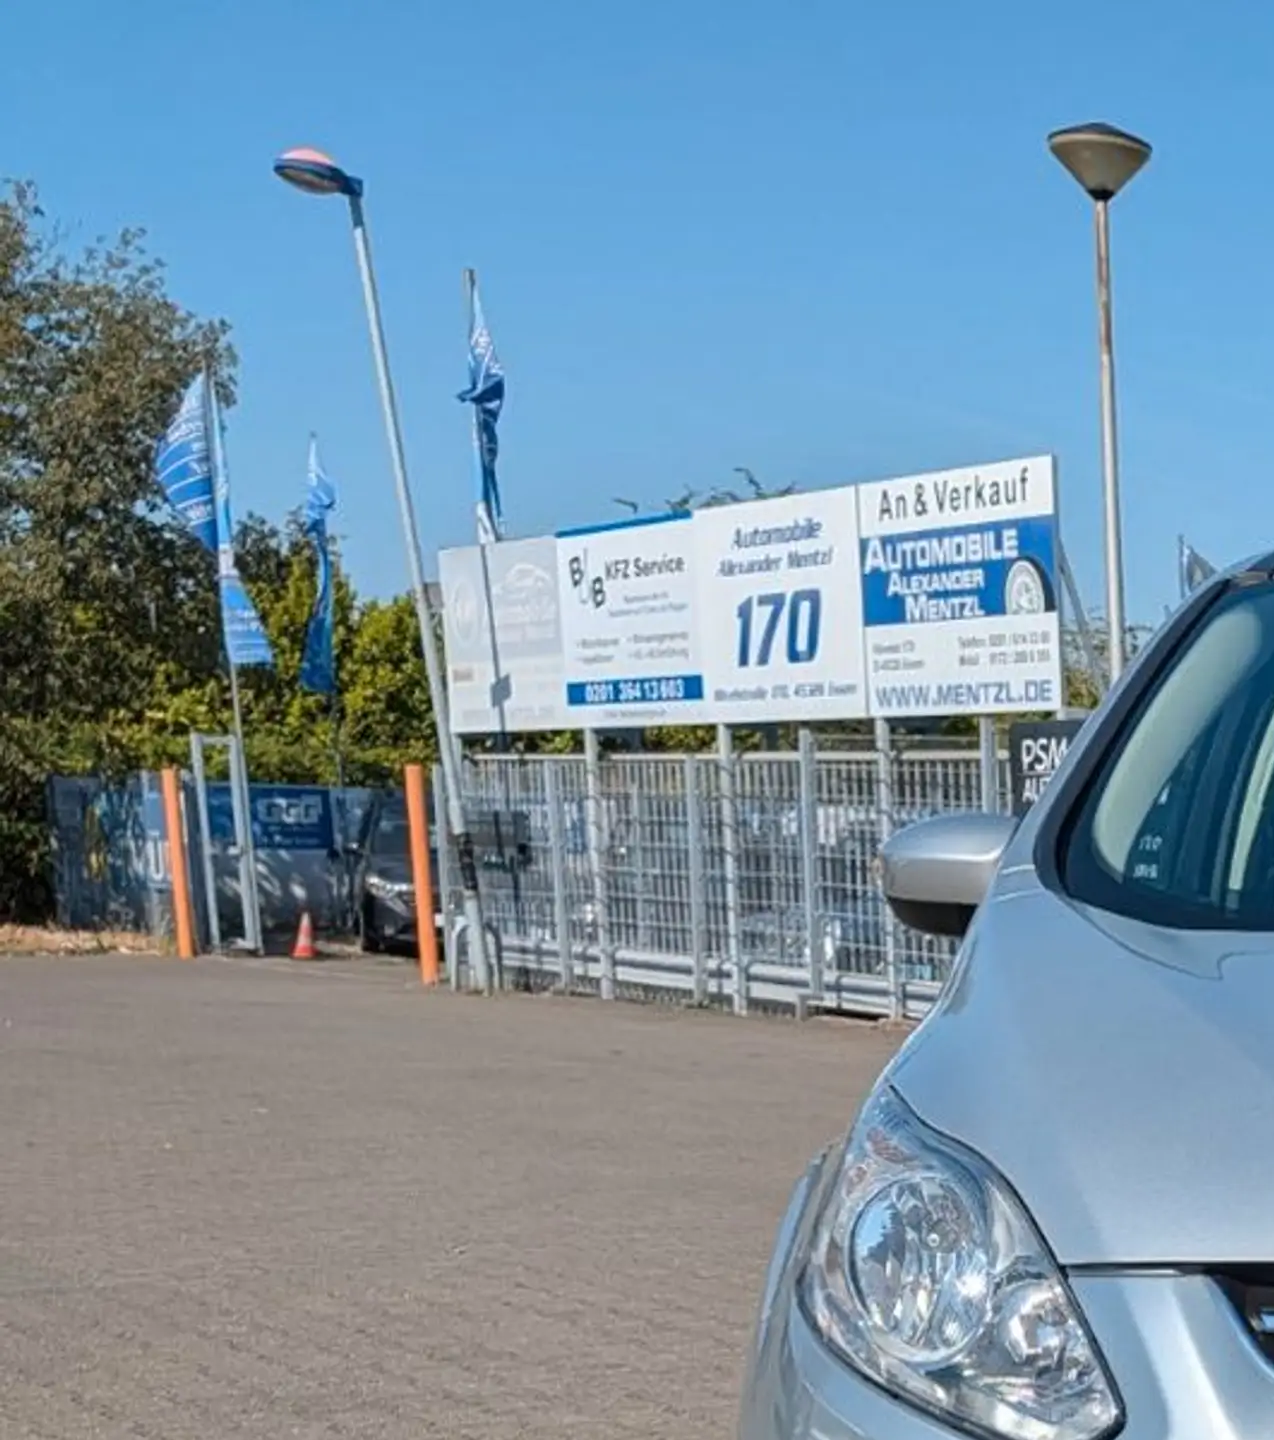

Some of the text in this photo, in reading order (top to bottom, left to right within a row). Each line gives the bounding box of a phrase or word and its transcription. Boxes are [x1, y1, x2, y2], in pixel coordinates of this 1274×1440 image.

[879, 466, 1029, 521] An & Verkauf
[733, 518, 822, 548] Automobile
[864, 528, 1018, 574] AUTOMOBILE
[605, 555, 685, 581] KFZ Service
[905, 594, 985, 624] MENTZL
[737, 588, 821, 668] 170
[876, 680, 1053, 708] WWW.MENTZL.DE
